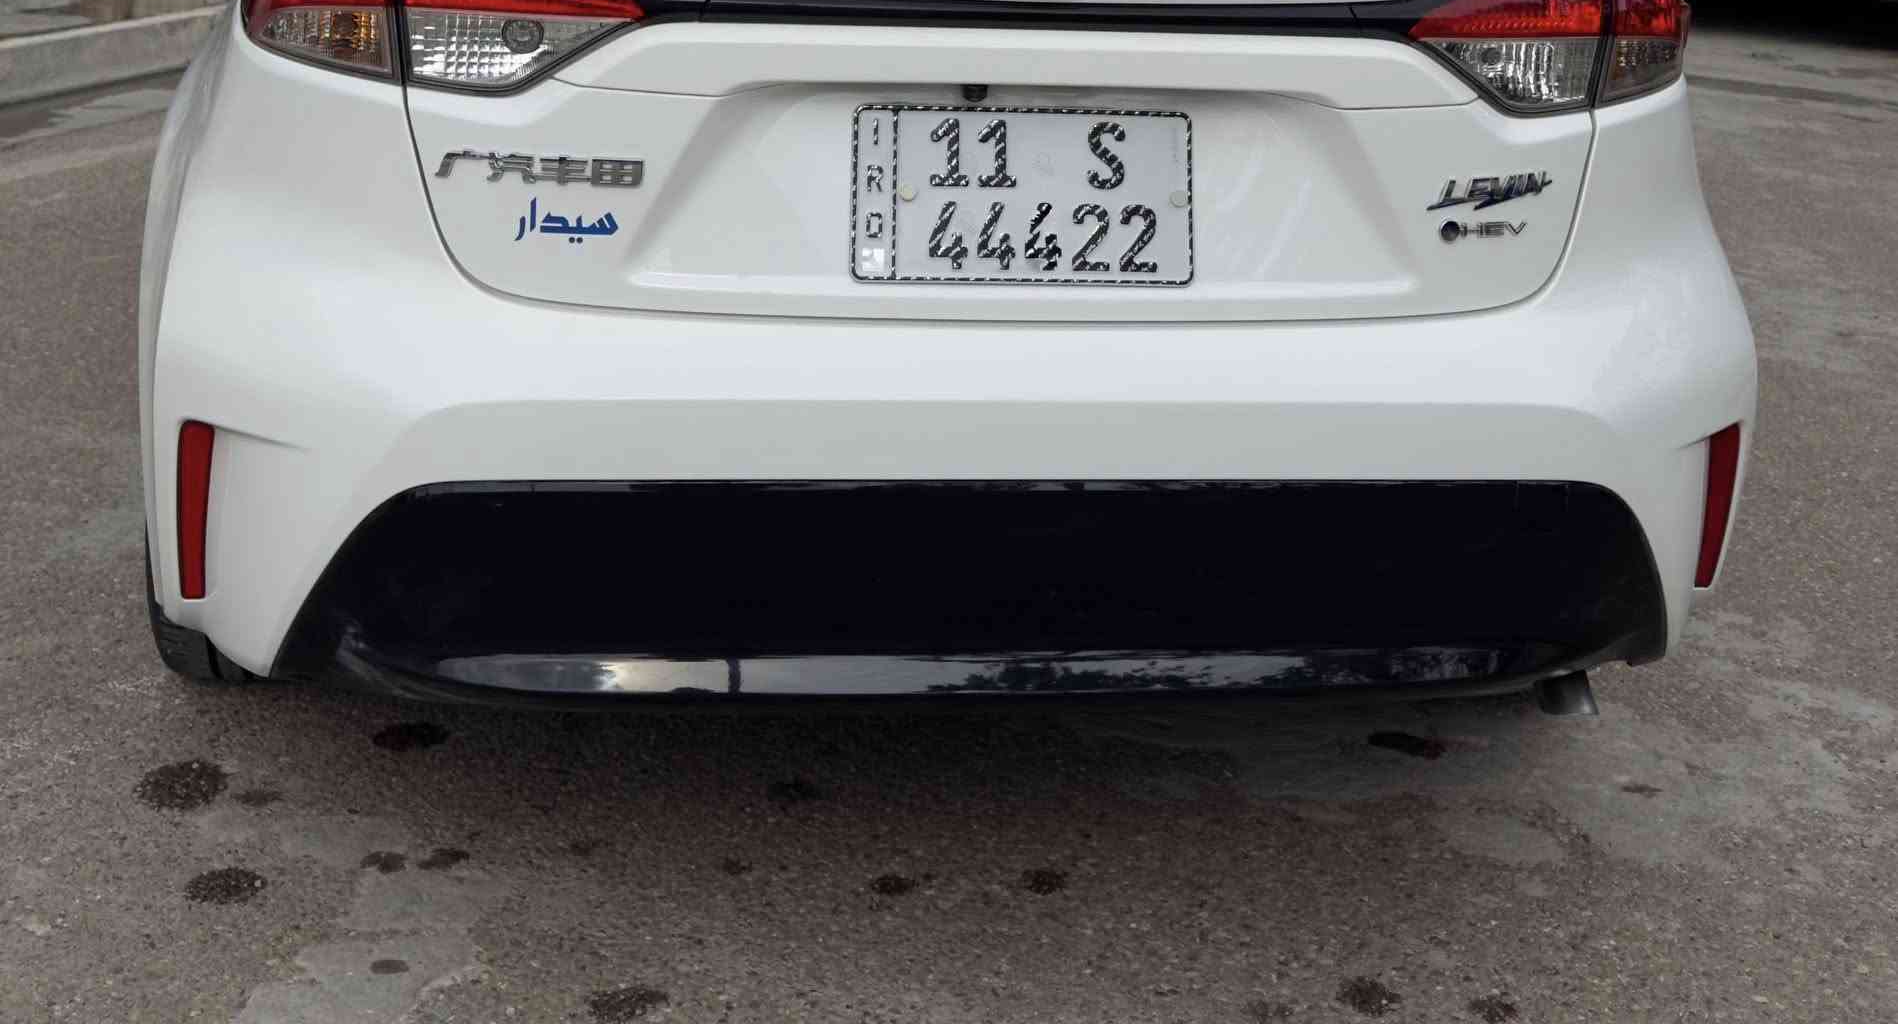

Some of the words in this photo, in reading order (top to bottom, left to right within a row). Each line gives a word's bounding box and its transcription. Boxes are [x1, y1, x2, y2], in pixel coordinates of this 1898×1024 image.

[929, 117, 1017, 188] 11
[1086, 121, 1126, 190] S
[928, 200, 1158, 273] 44422
